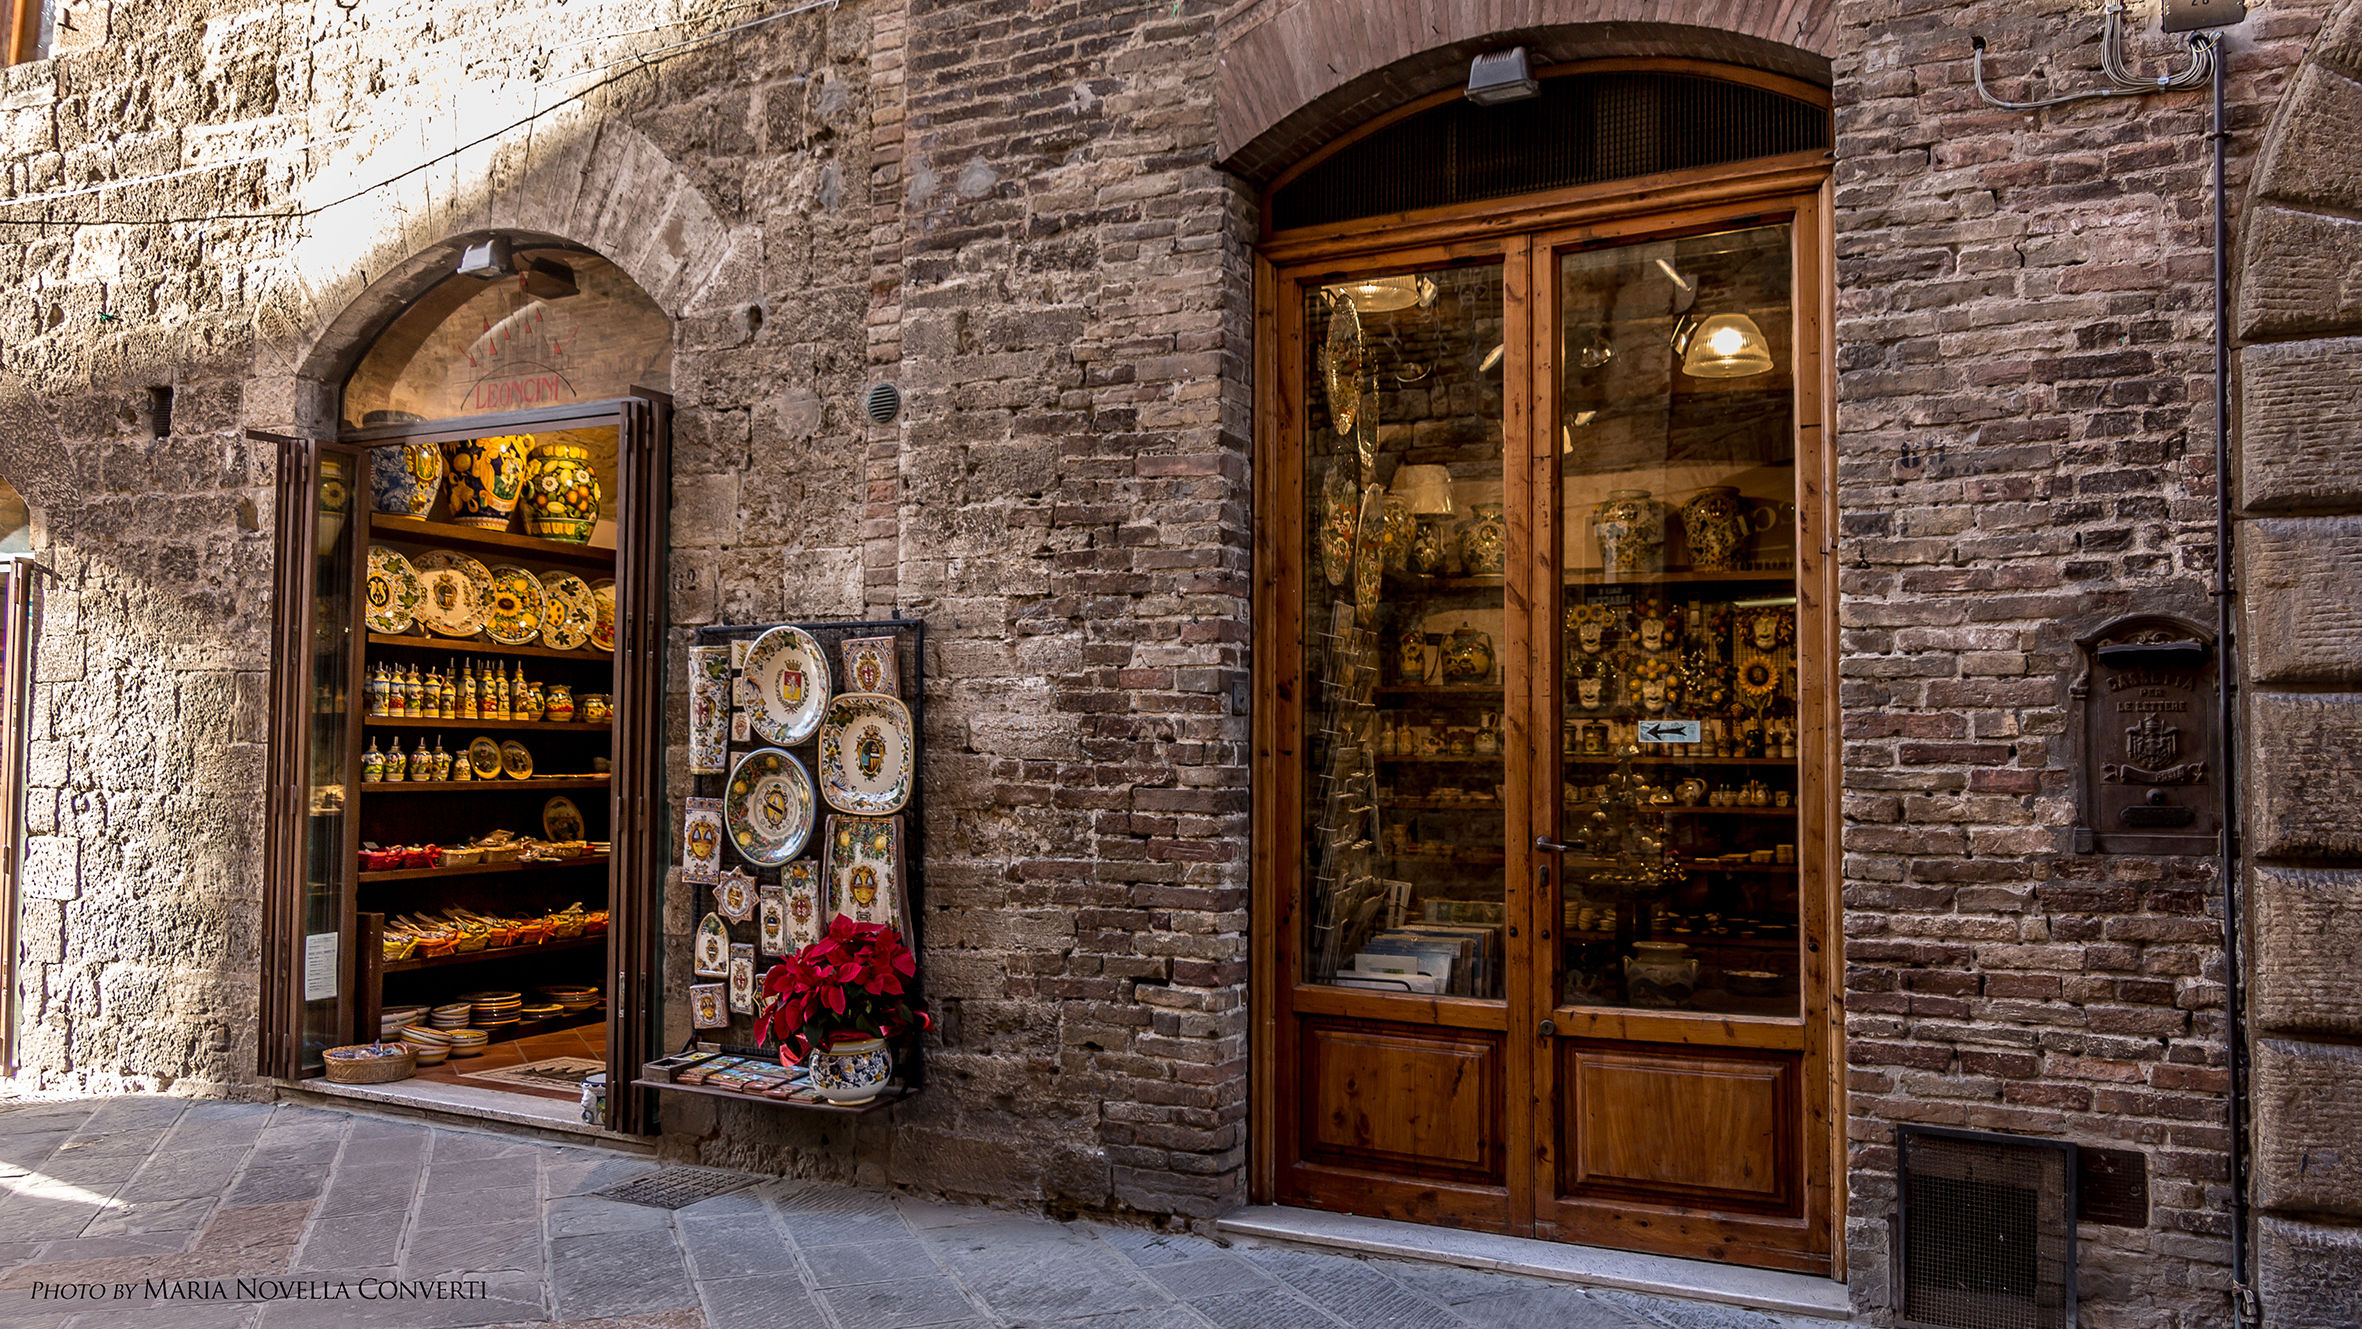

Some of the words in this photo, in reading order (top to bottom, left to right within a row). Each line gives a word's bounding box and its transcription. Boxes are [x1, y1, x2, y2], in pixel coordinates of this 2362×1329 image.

[475, 375, 559, 410] LEONCINI
[2140, 687, 2163, 698] PER
[2116, 701, 2132, 713] LE
[2135, 701, 2187, 713] LETTERE
